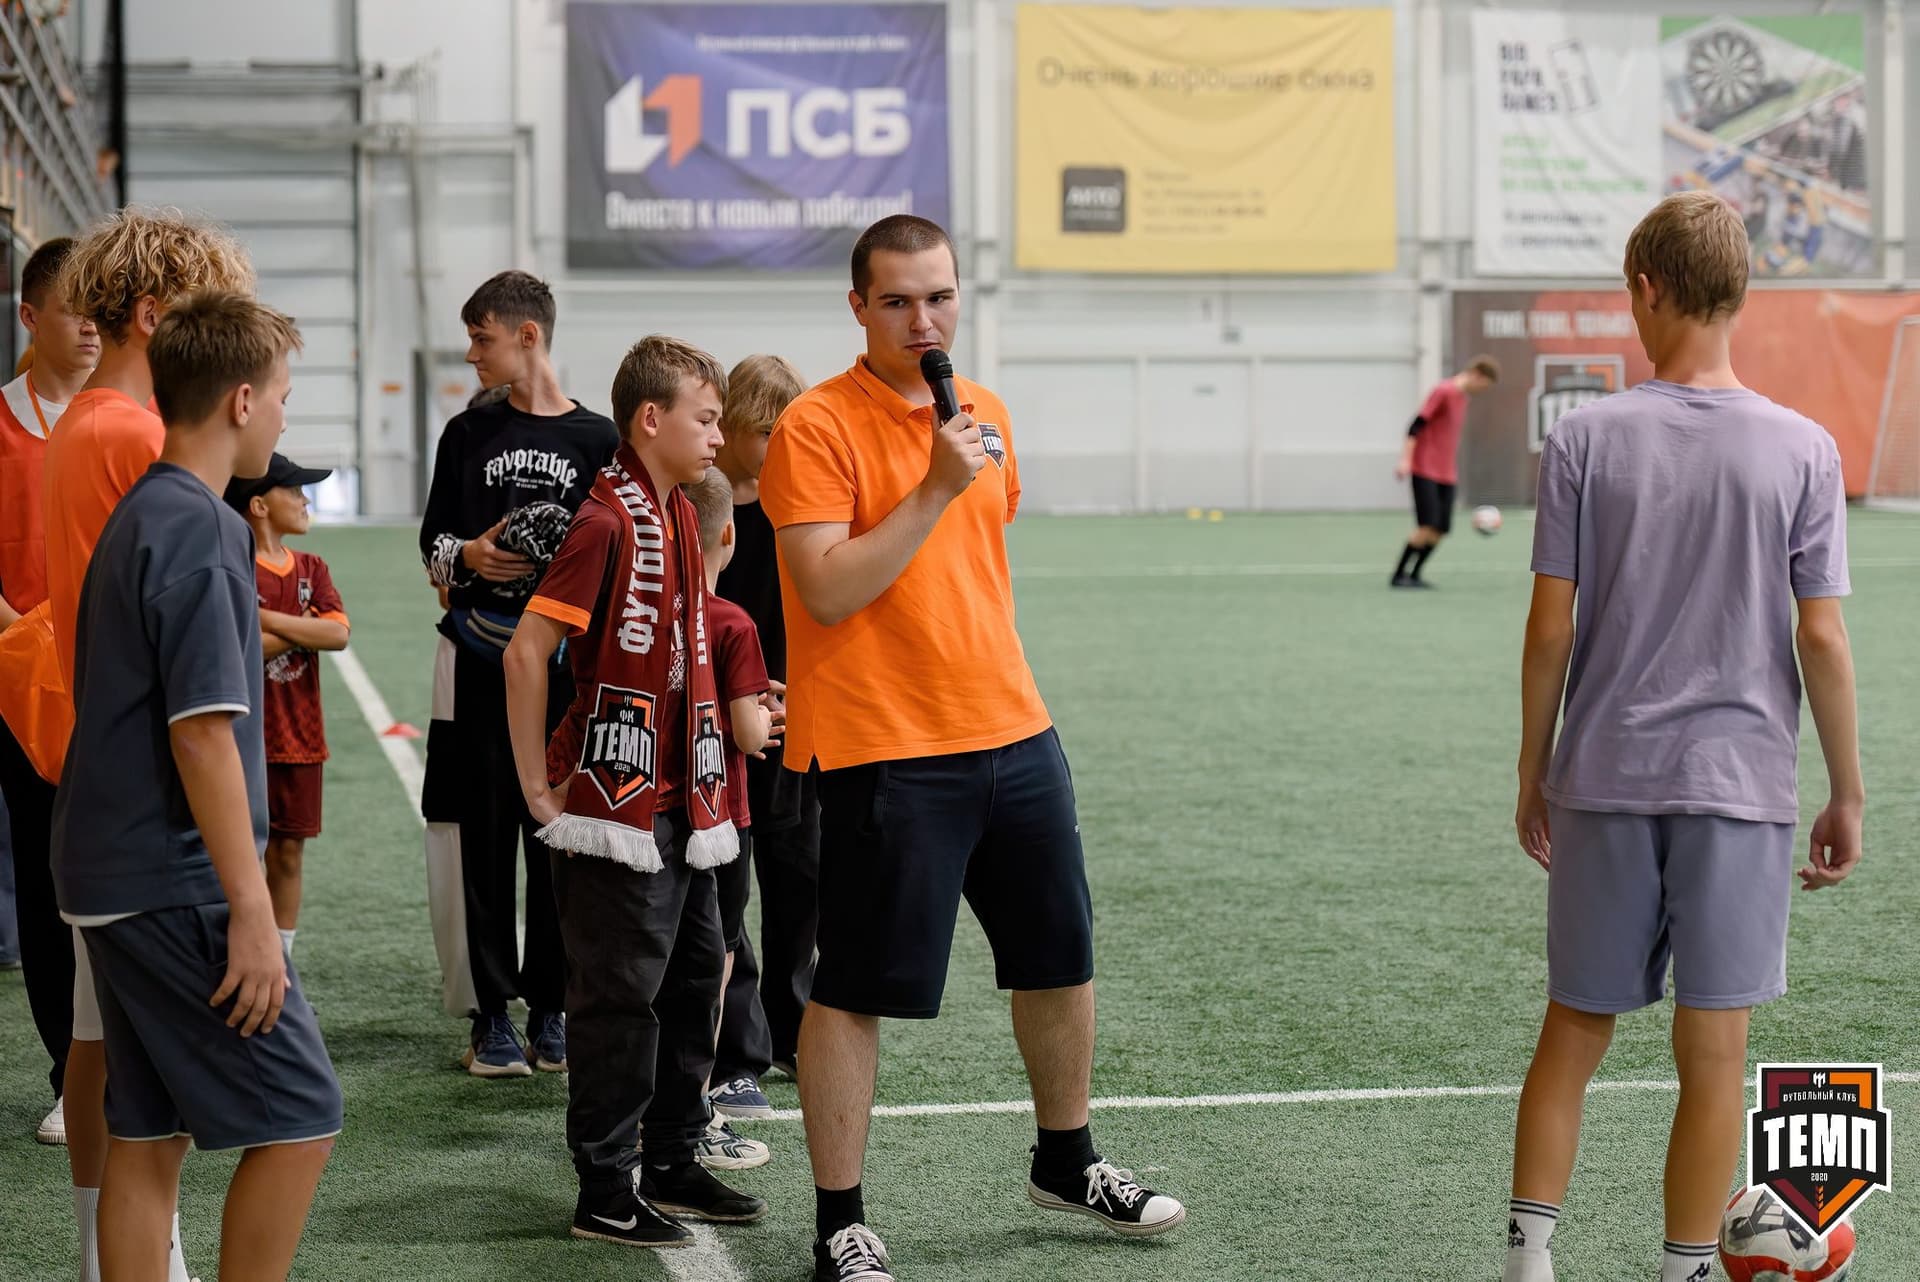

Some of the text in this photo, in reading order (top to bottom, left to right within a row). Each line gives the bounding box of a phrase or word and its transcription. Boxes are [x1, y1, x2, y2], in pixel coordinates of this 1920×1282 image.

[726, 86, 912, 160] ПСБ
[483, 448, 578, 500] favorable
[619, 709, 635, 723] ФК
[592, 721, 652, 775] ТЕМП
[613, 762, 631, 773] 2020
